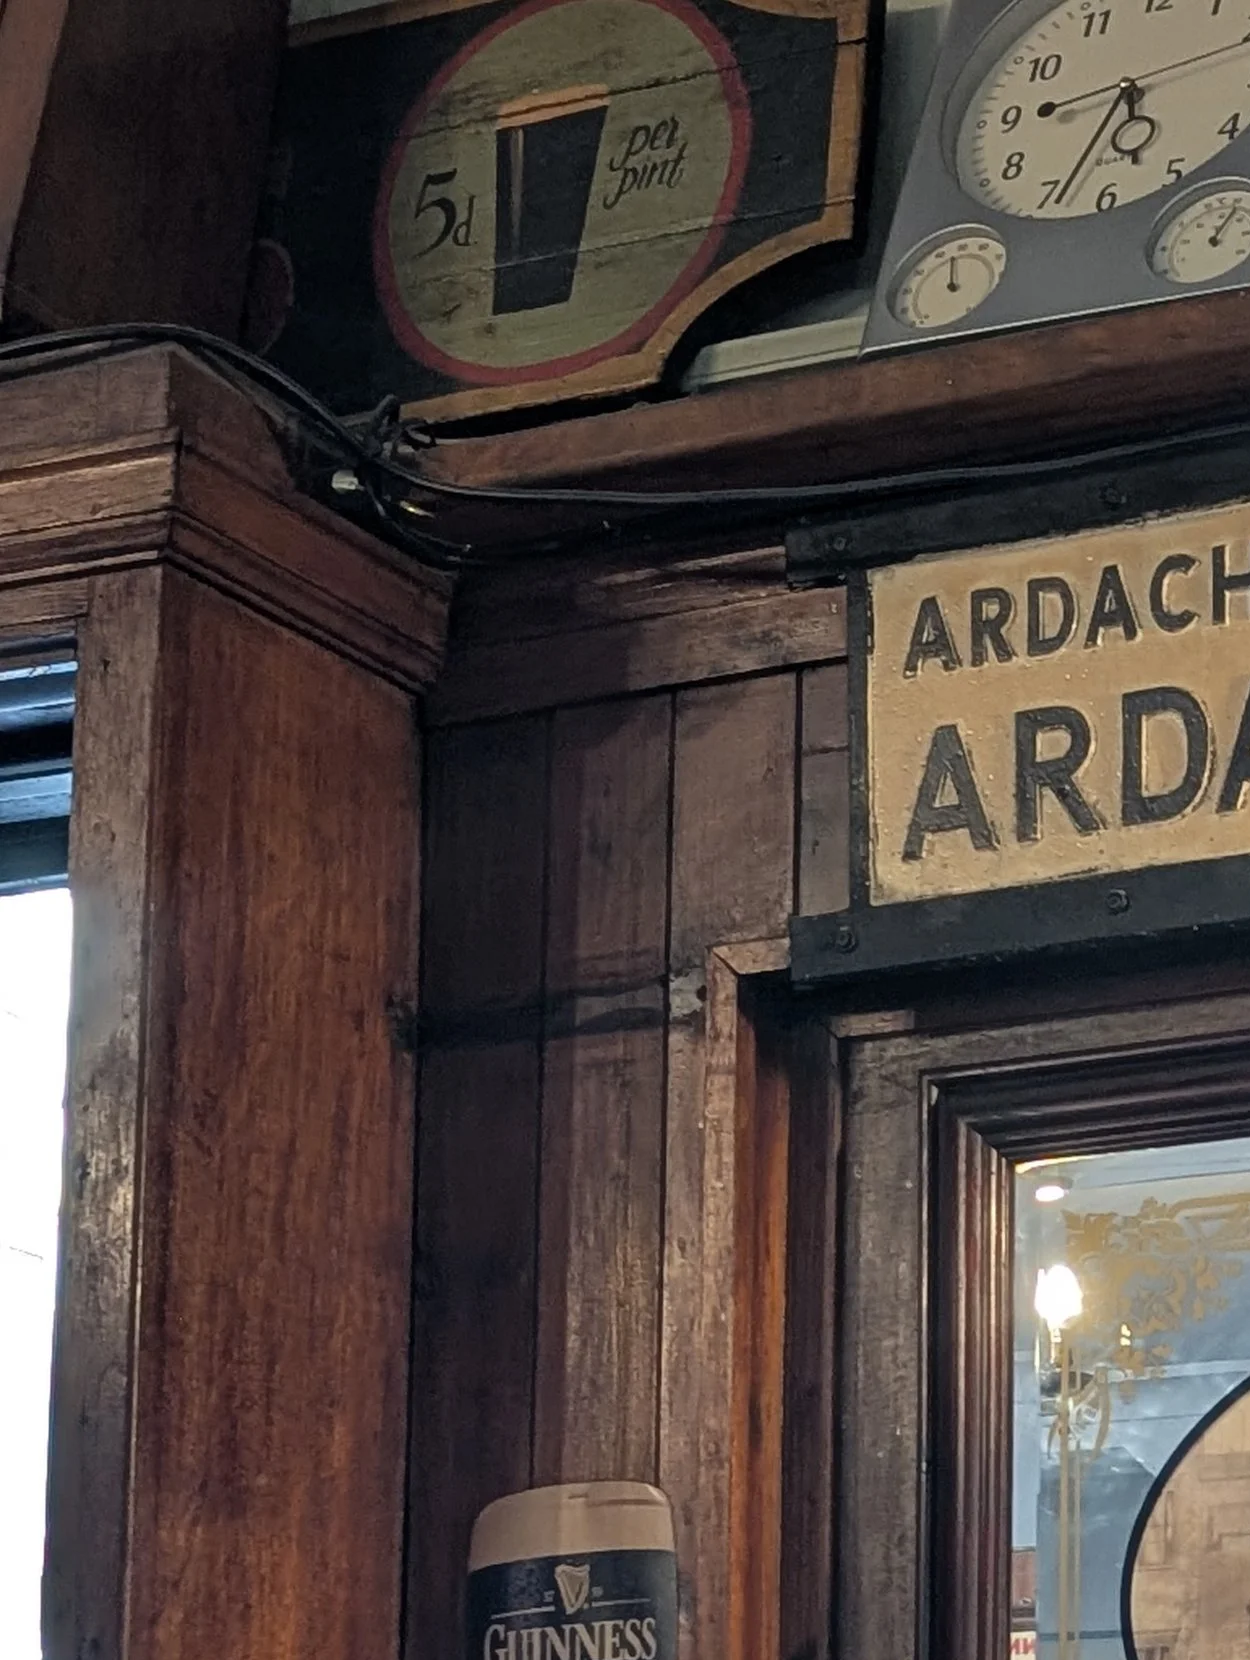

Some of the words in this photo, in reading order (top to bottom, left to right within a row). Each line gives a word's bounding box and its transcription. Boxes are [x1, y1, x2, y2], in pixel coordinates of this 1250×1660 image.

[1082, 9, 1111, 37] 11
[1028, 54, 1062, 83] 10
[1001, 106, 1022, 134] 9
[1217, 112, 1240, 140] 4
[609, 116, 680, 172] per
[603, 141, 689, 210] pint
[1001, 151, 1025, 181] 8
[1037, 180, 1061, 210] 7
[1096, 182, 1118, 212] 6
